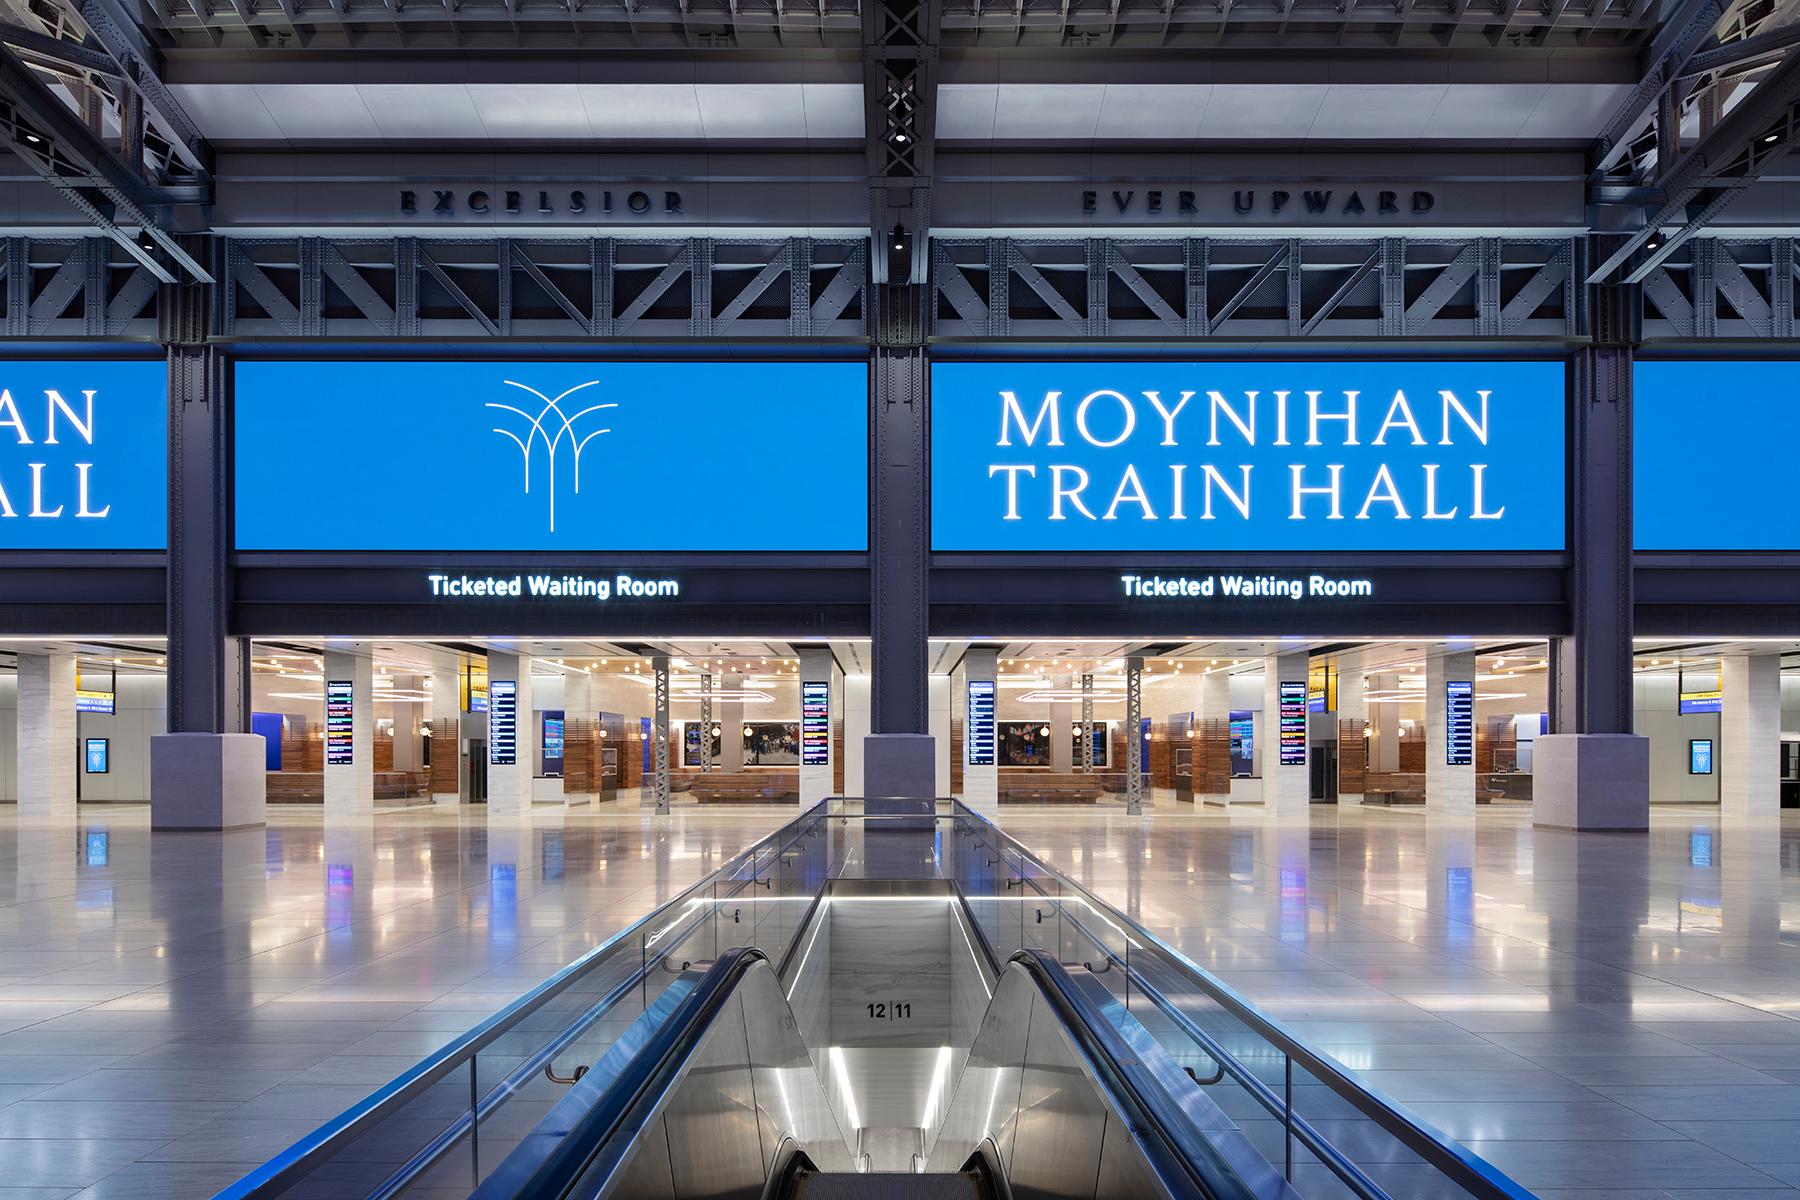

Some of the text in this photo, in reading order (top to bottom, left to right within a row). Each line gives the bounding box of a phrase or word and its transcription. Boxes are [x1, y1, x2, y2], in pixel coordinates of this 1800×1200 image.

[400, 190, 683, 213] EXCELSIOR
[1082, 190, 1435, 213] EVER UPWARD
[997, 389, 1491, 447] MOYNIHAN
[988, 463, 1505, 520] TRAIN HALL
[428, 575, 679, 600] Ticketed Waiting Room
[1120, 575, 1371, 600] Ticketed Waiting Room
